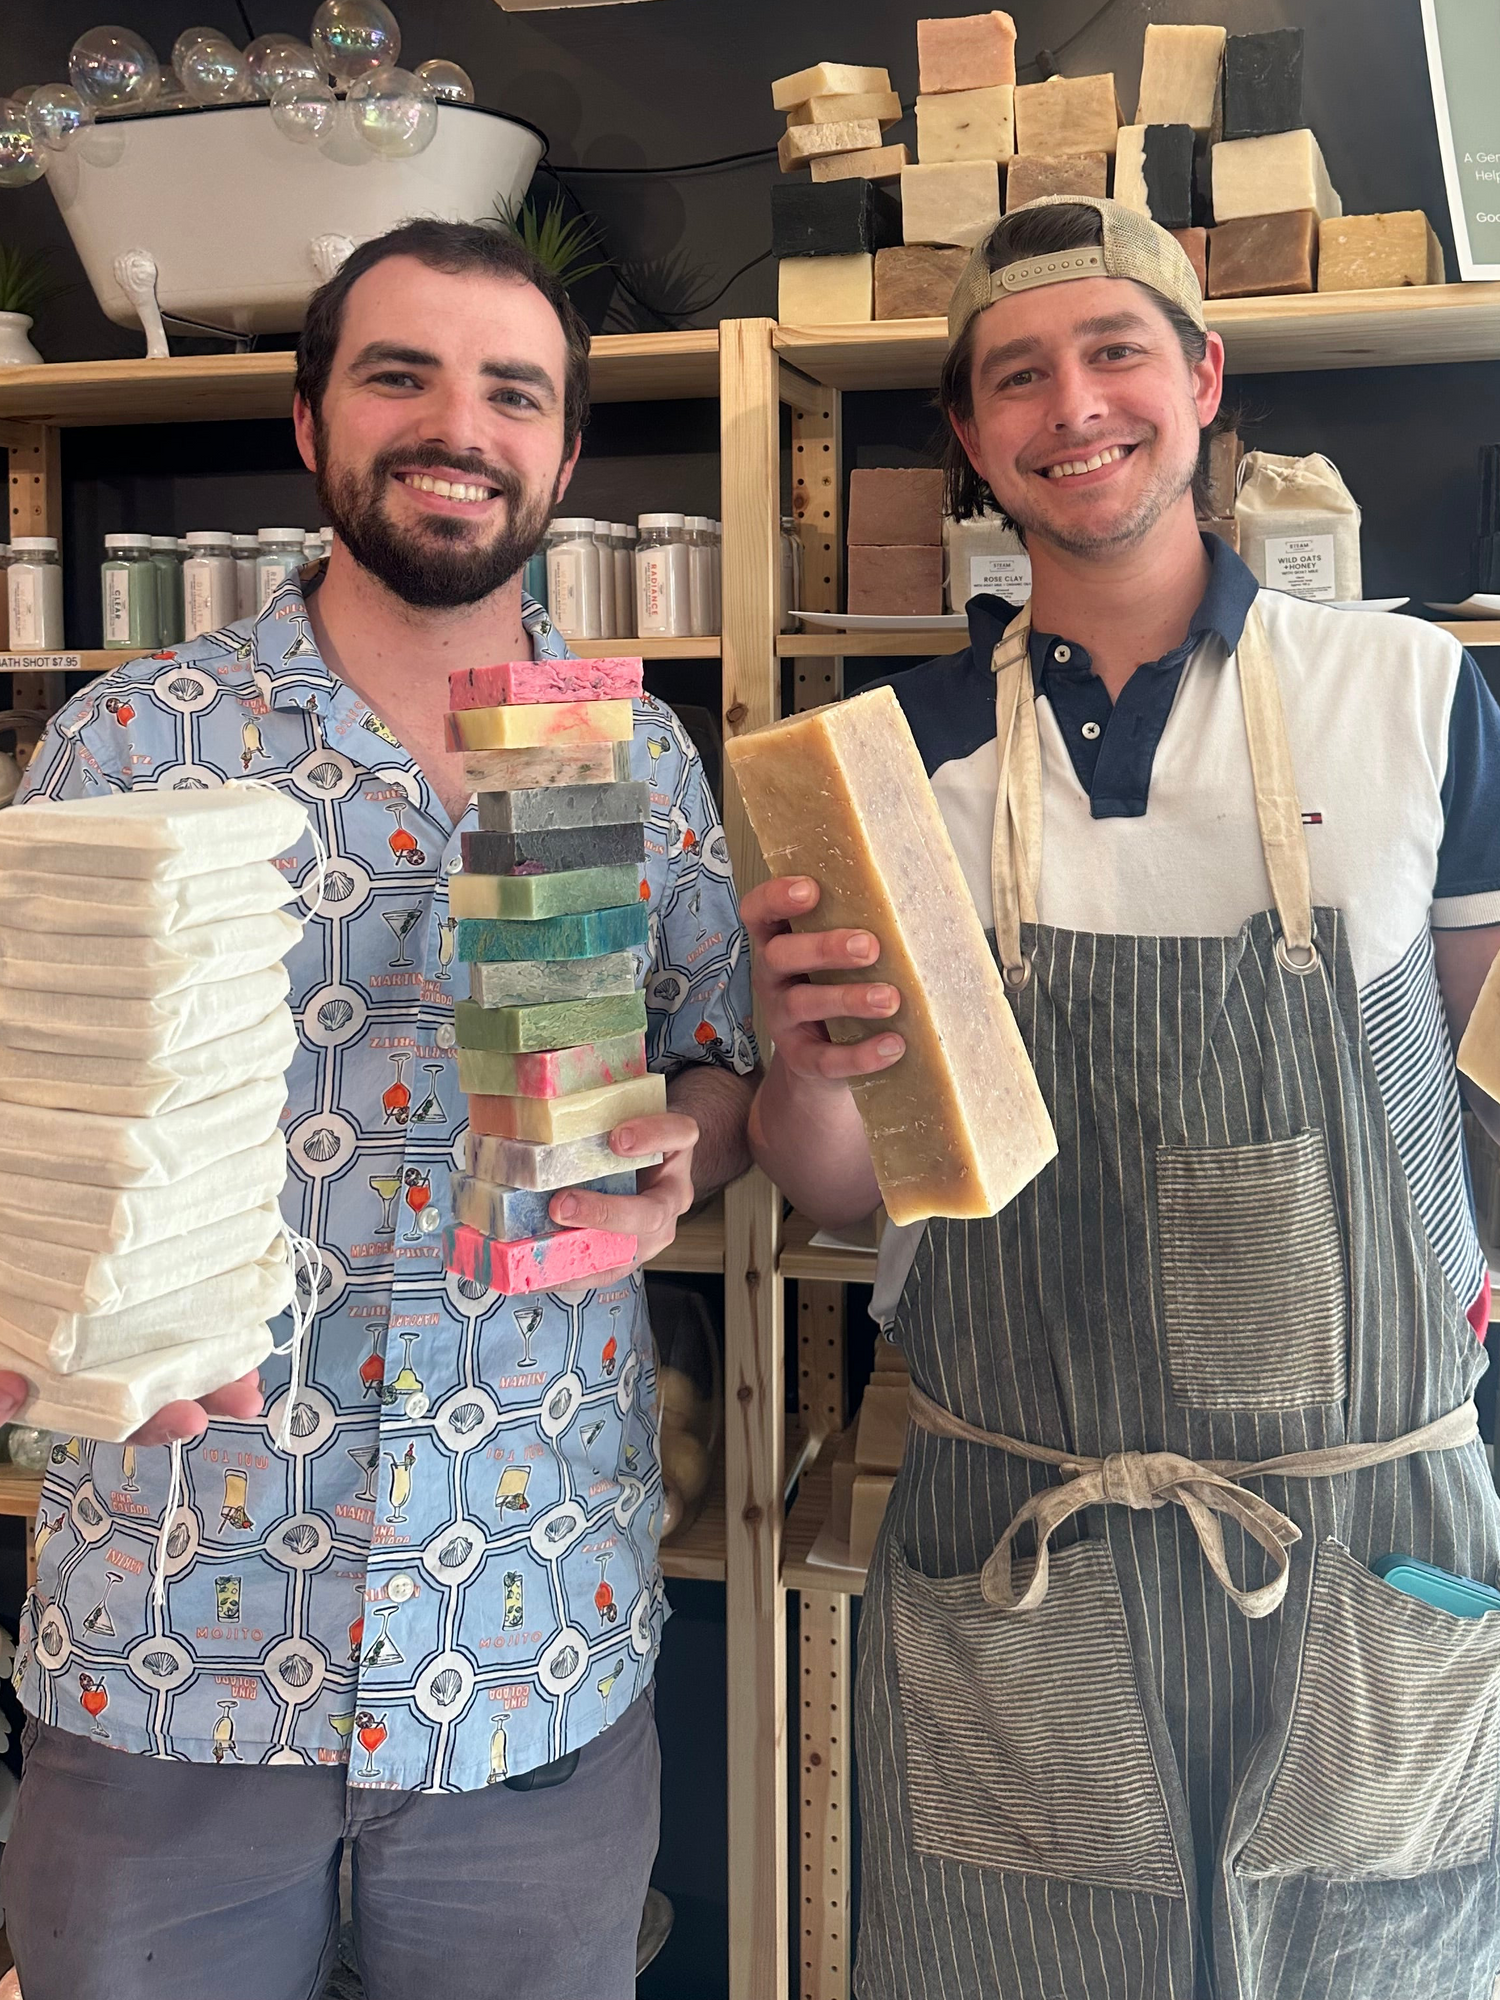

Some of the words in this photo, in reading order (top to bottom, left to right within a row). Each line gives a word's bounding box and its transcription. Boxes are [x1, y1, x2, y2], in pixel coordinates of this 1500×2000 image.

[1464, 153, 1473, 163] A
[651, 563, 659, 616] RADIANCE
[0, 658, 20, 667] ATH
[23, 657, 50, 667] SHOT
[52, 656, 78, 667] $7.95
[499, 1371, 549, 1389] MARTINI
[110, 1491, 133, 1505] PINA
[112, 1501, 150, 1516] COLADA
[105, 1547, 144, 1576] MARTINI
[196, 1627, 263, 1640] MOJITO
[479, 1631, 542, 1648] MOJITO
[231, 1688, 258, 1700] PINA
[489, 1685, 530, 1700] COLADA
[504, 1697, 528, 1711] PINA
